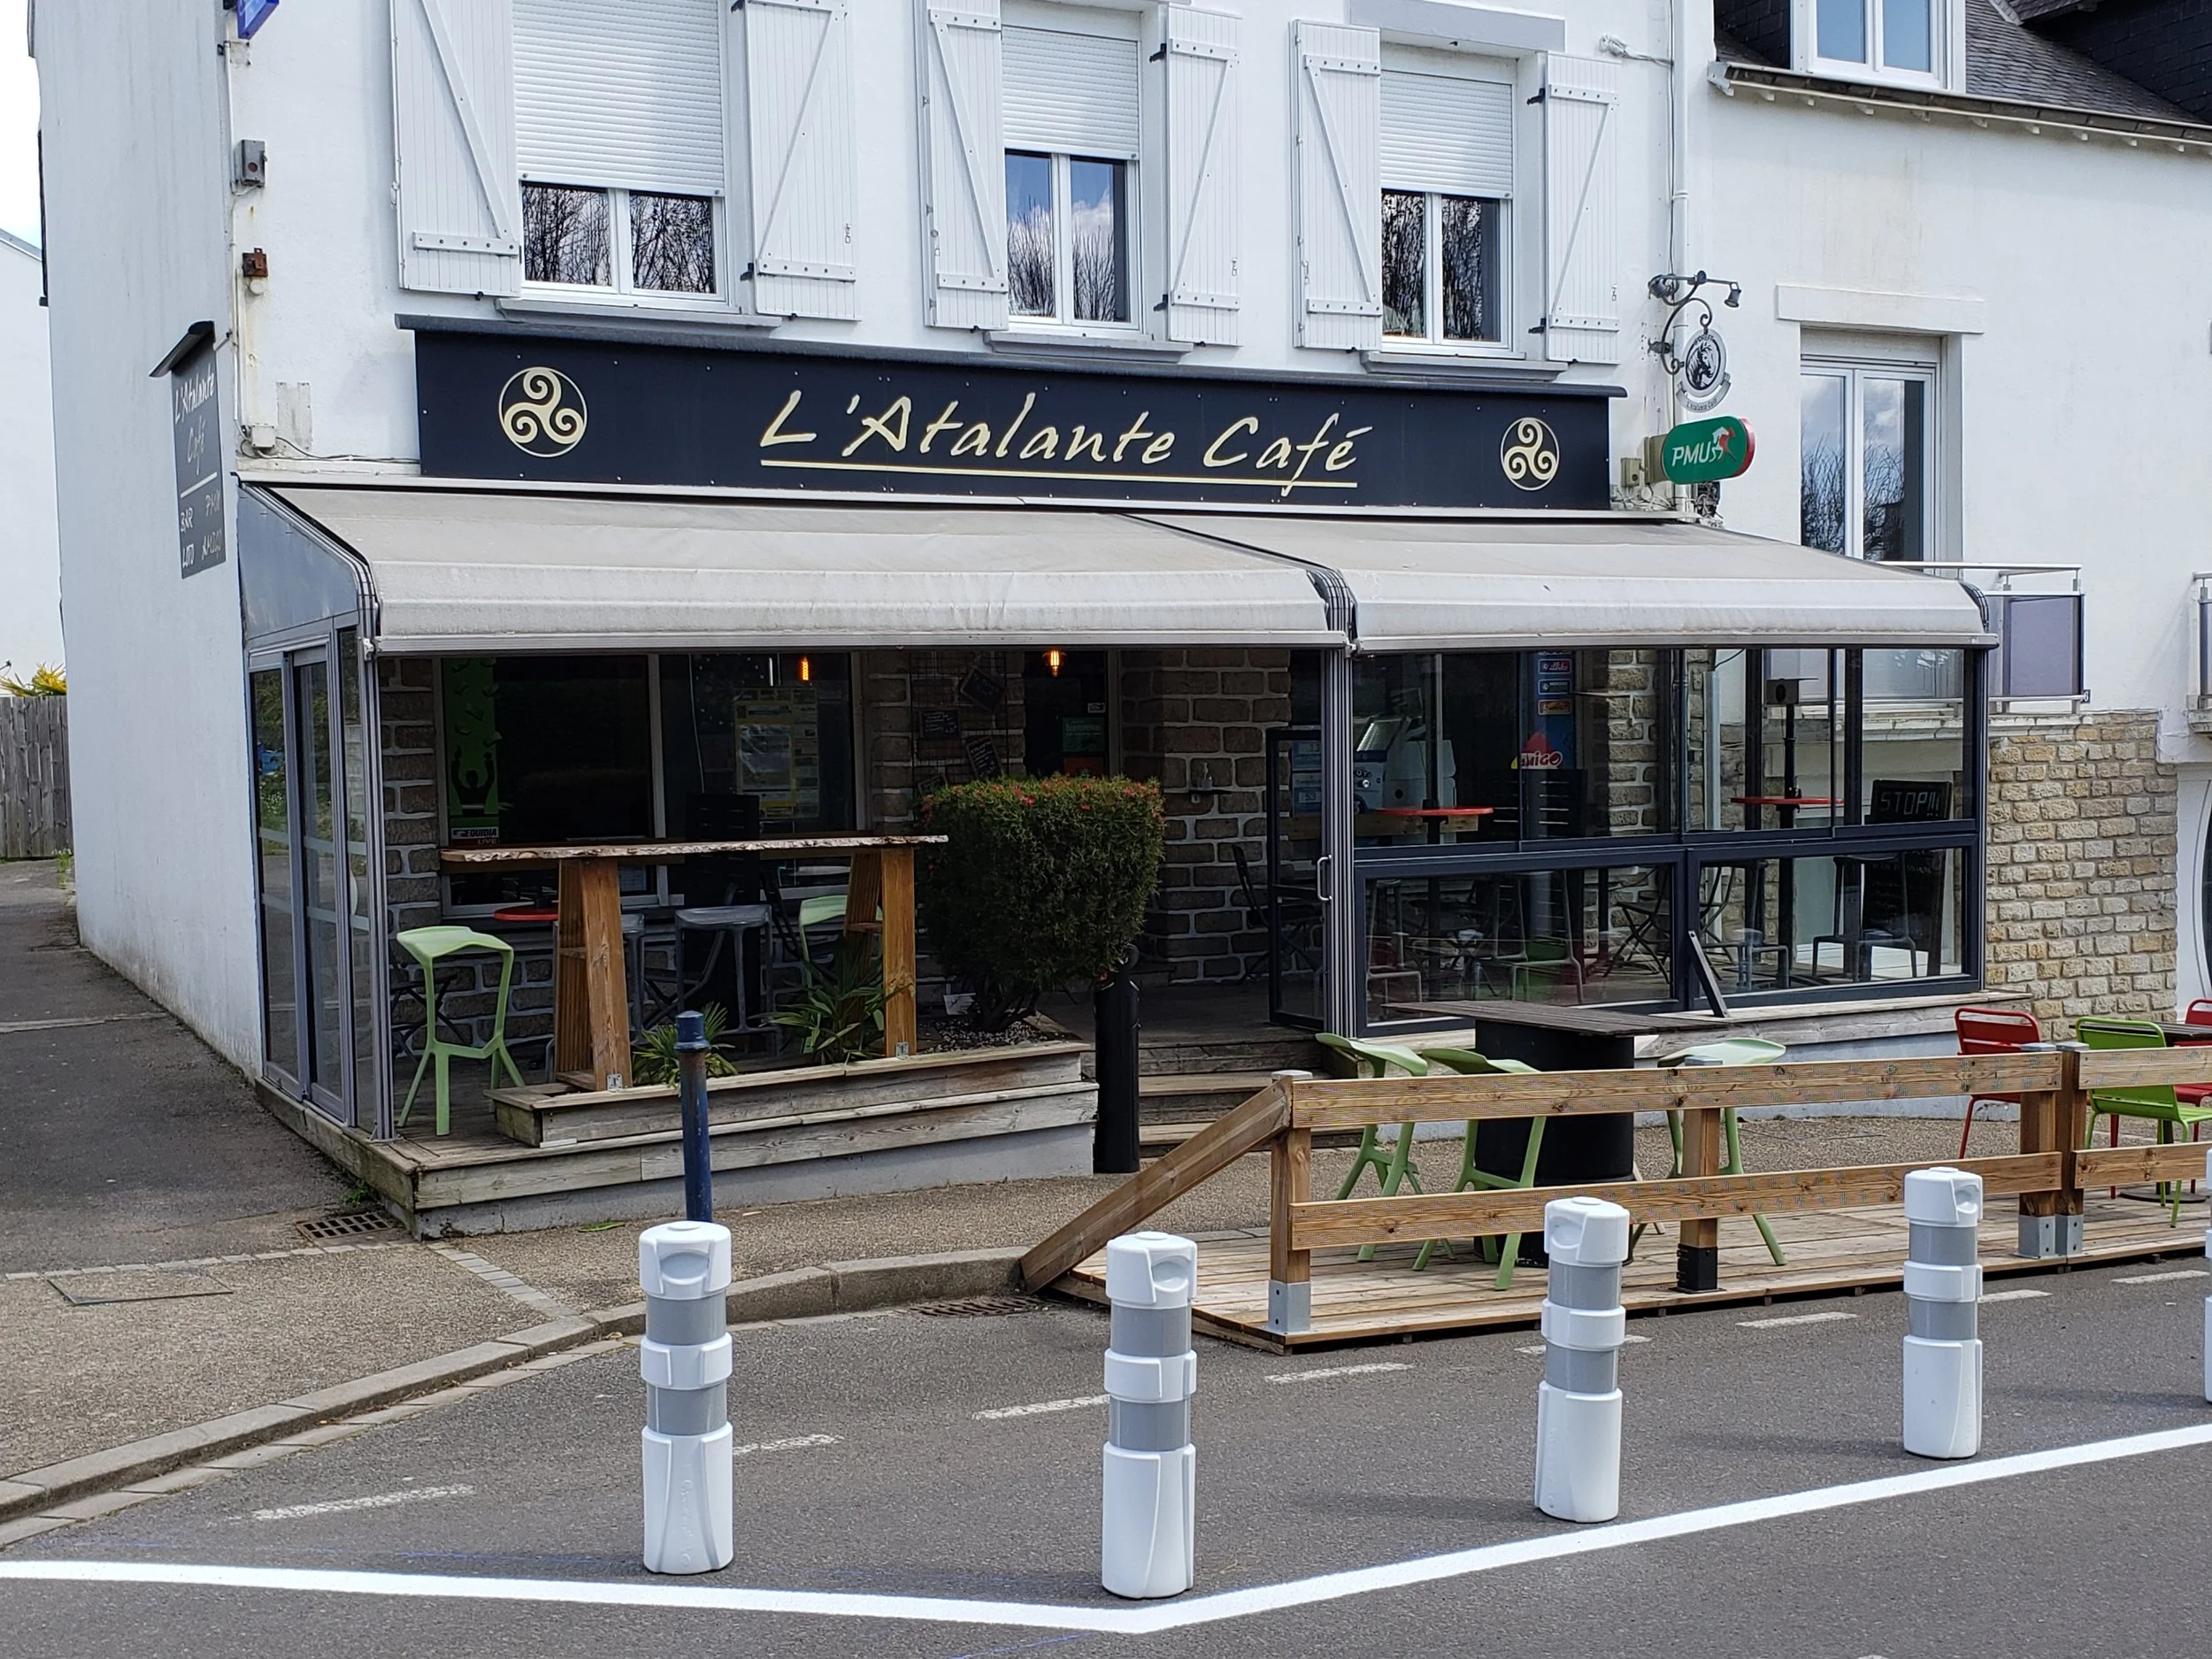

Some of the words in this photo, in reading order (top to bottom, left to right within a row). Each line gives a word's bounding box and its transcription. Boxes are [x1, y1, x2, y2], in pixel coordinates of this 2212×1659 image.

[187, 414, 205, 475] Café
[760, 390, 1172, 465] L'Atalante
[1202, 411, 1373, 496] Café
[1671, 441, 1711, 467] PMU
[180, 507, 194, 533] BAR
